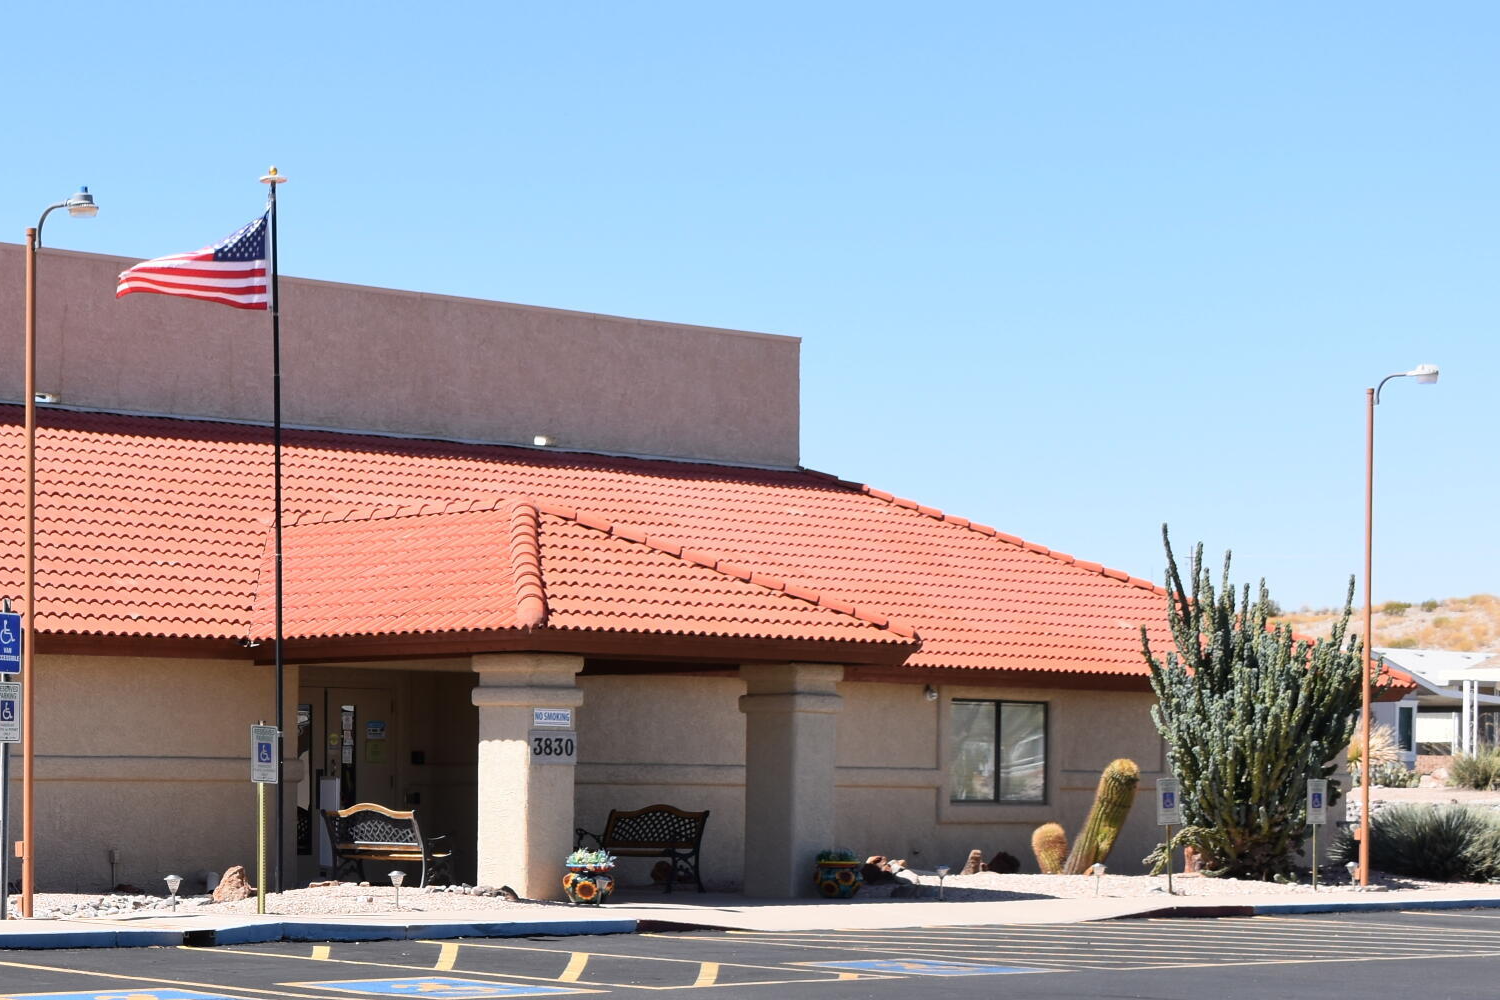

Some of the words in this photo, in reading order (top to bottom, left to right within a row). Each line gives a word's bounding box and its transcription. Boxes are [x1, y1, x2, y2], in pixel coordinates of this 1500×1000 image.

[535, 712, 543, 720] NO
[544, 712, 570, 721] SMOKING
[533, 737, 574, 757] 3830
